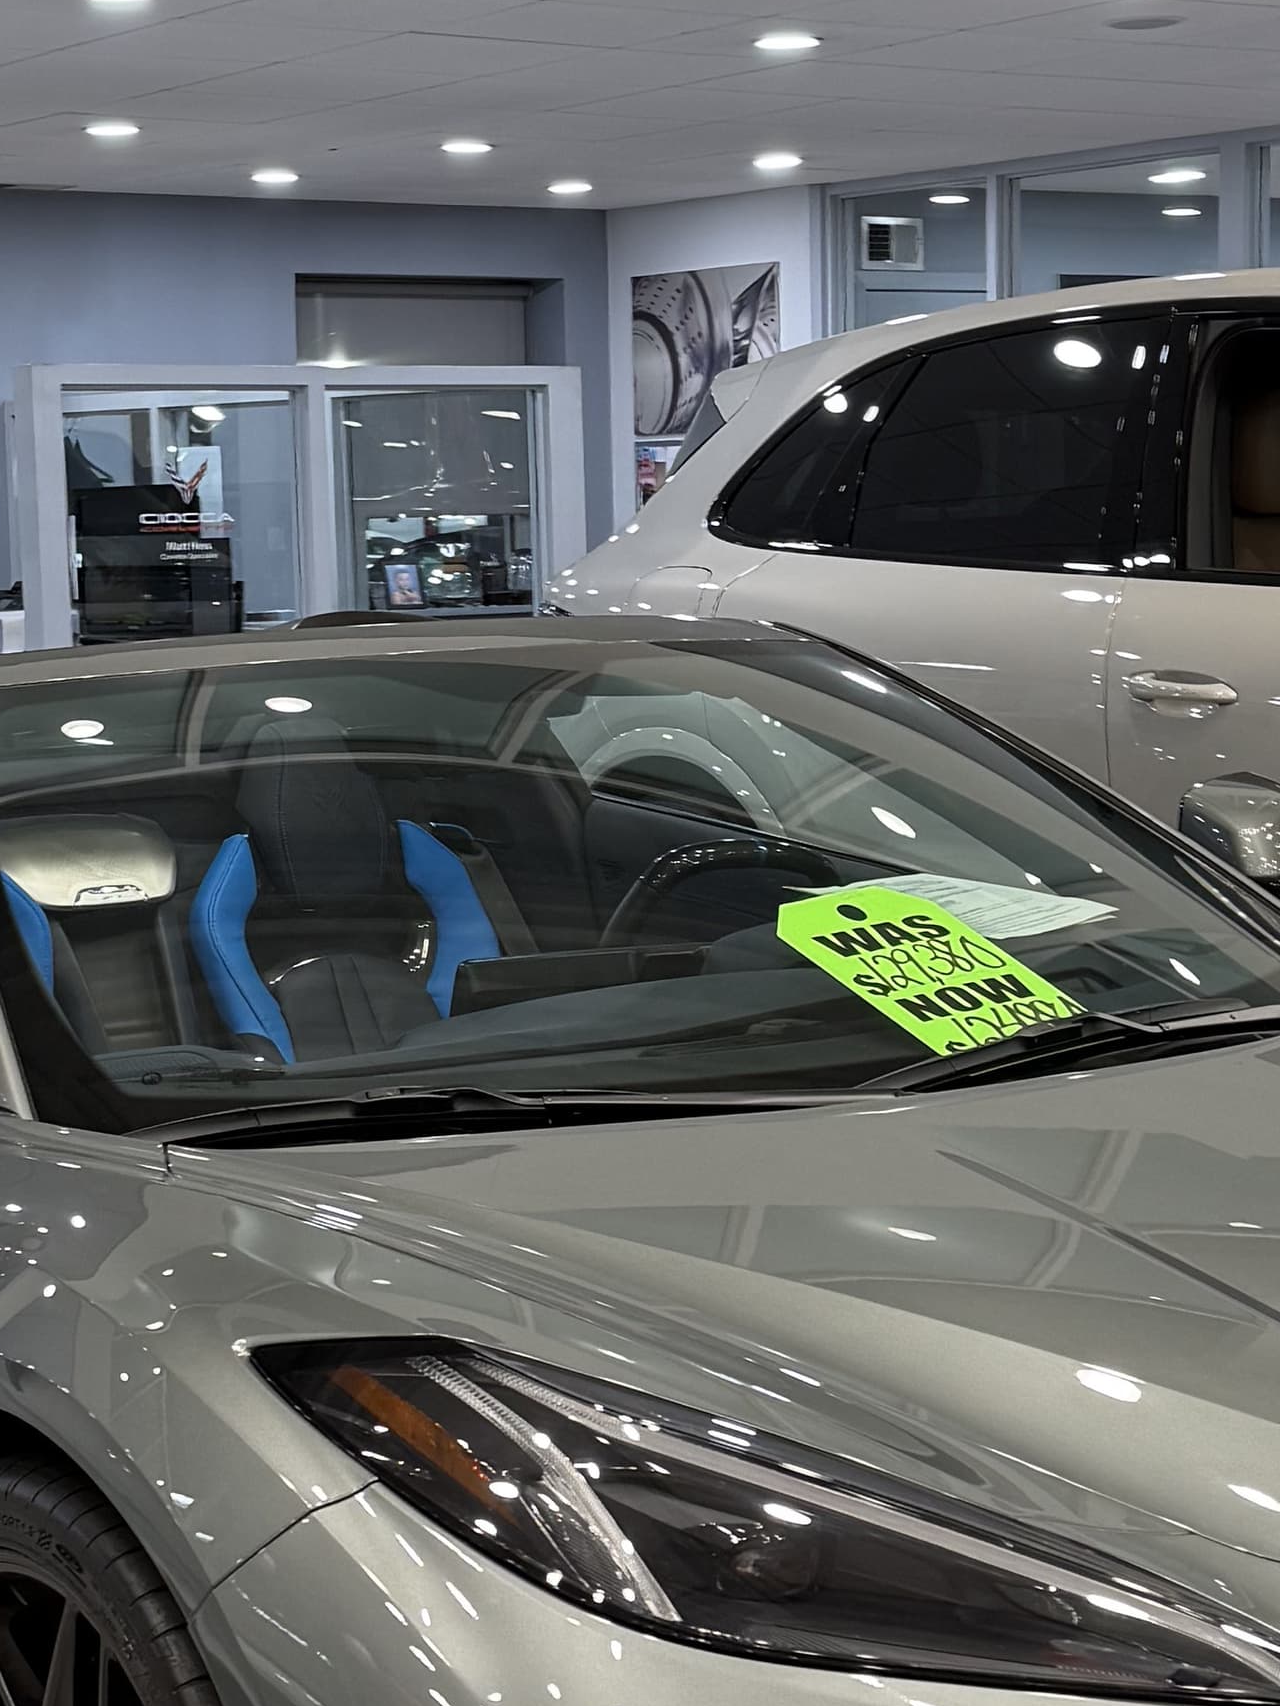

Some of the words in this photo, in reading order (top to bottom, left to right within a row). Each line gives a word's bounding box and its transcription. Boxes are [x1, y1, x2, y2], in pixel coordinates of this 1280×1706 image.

[139, 512, 235, 524] CIOCCA
[811, 915, 950, 957] WAS
[894, 974, 1036, 1022] NOW
